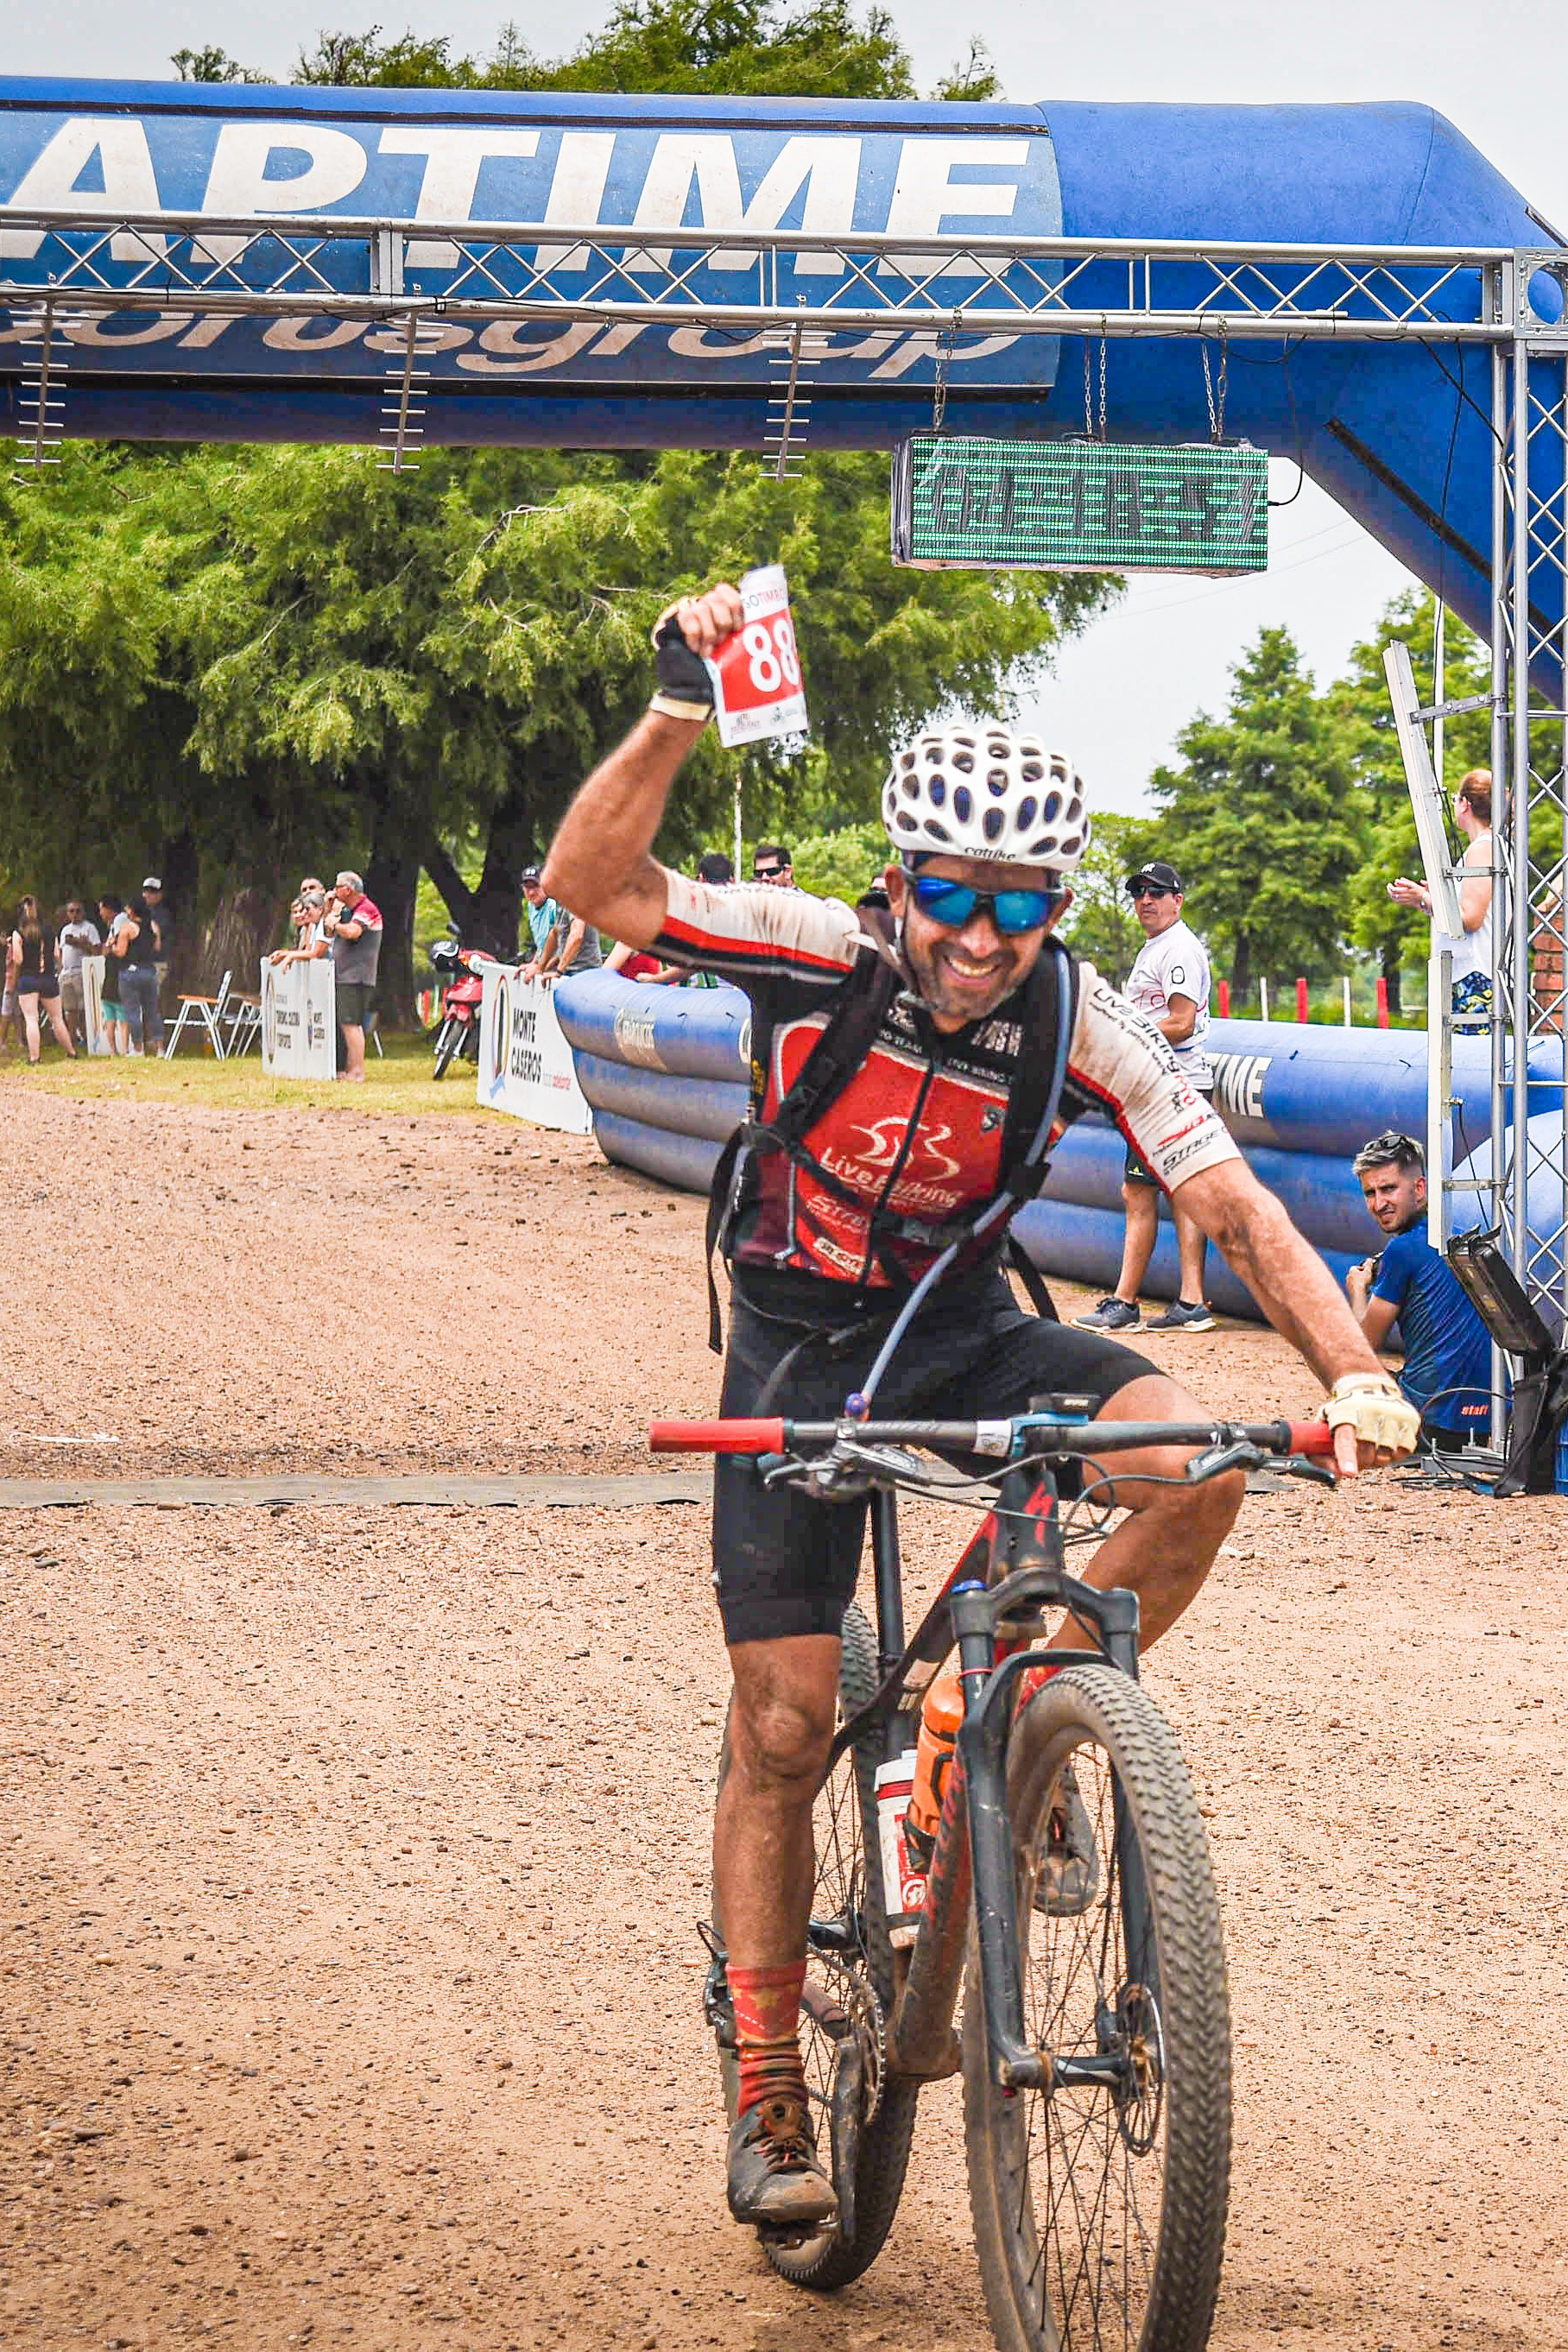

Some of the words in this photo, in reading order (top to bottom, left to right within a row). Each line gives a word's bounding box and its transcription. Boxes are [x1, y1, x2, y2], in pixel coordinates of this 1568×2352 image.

[743, 618, 800, 692] 88
[512, 1007, 537, 1043] MONTE
[511, 1046, 542, 1084] CASEROS
[1461, 1404, 1489, 1416] staff
